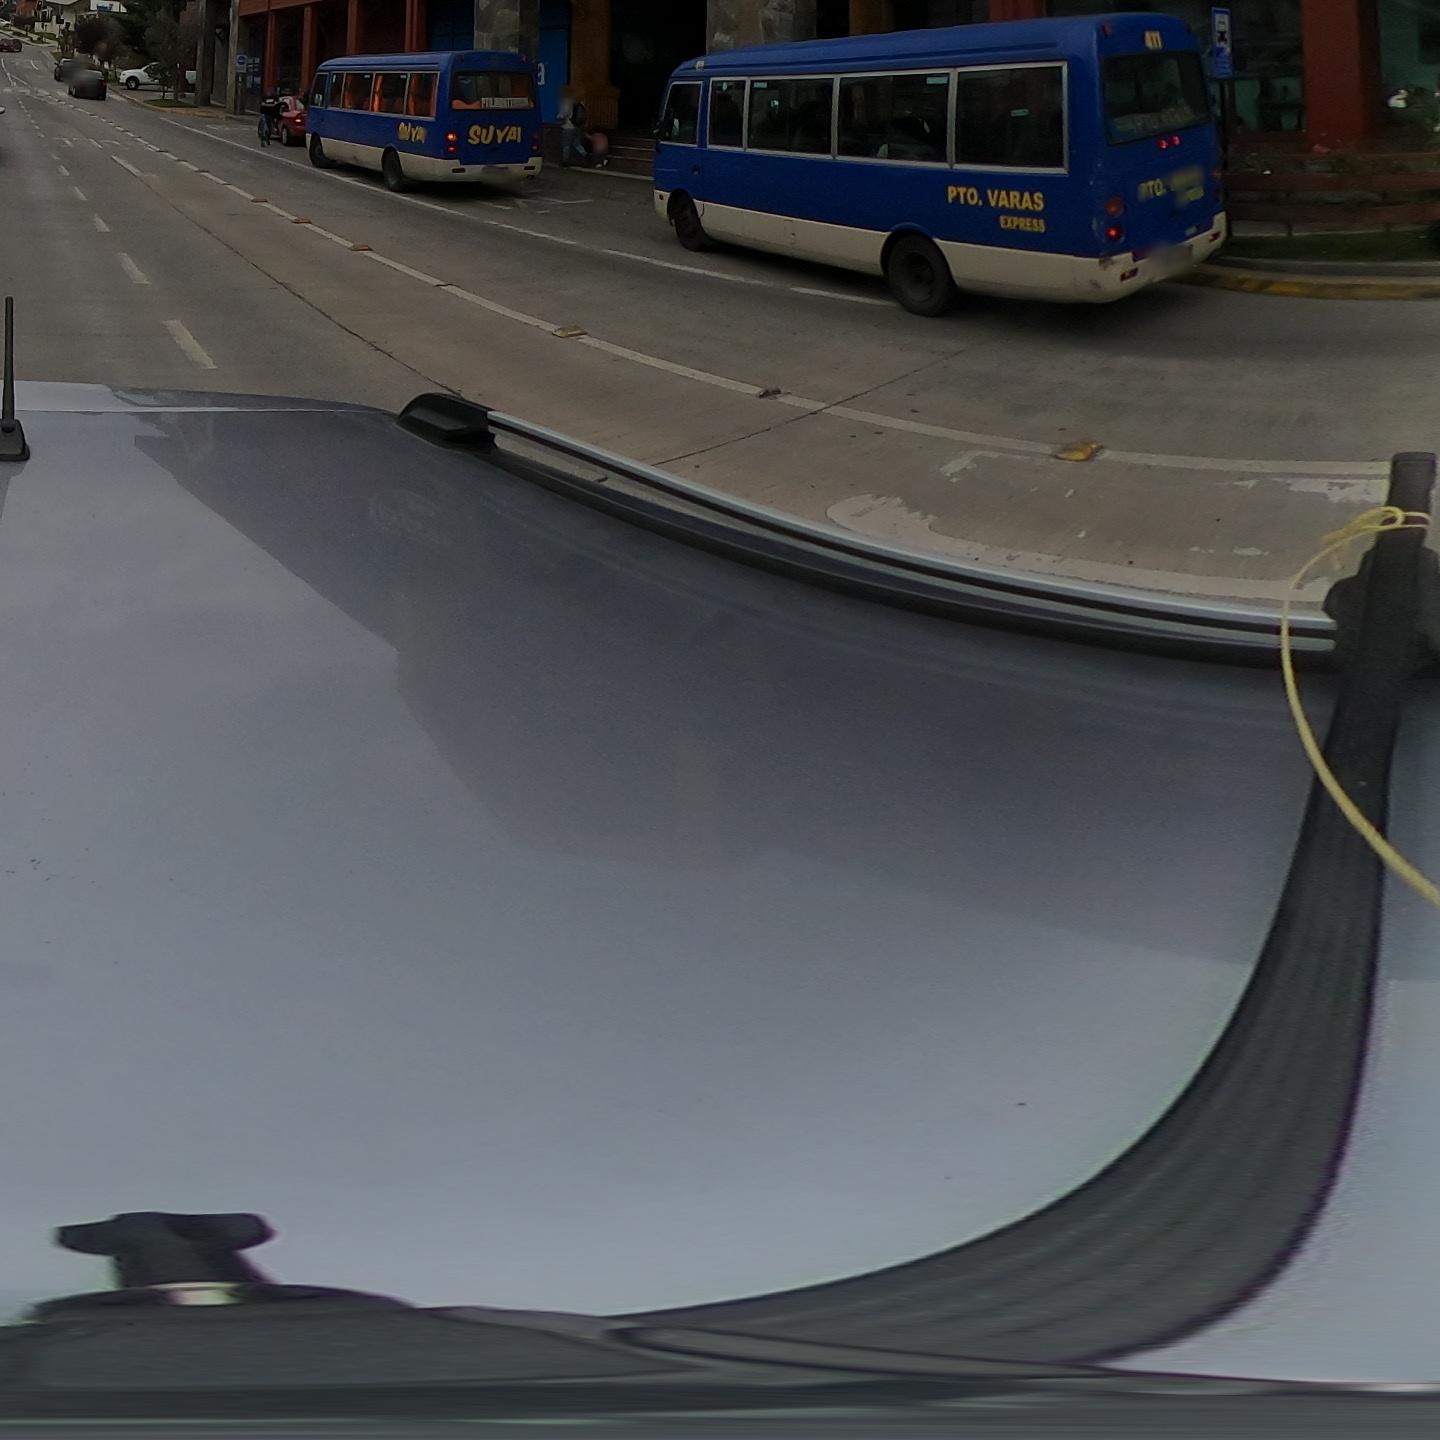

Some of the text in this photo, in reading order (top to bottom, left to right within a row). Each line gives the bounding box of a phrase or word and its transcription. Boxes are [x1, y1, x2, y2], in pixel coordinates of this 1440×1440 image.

[467, 124, 523, 145] SUYAI
[946, 185, 1045, 212] PTO. VARAS
[999, 214, 1047, 234] EXPRESS
